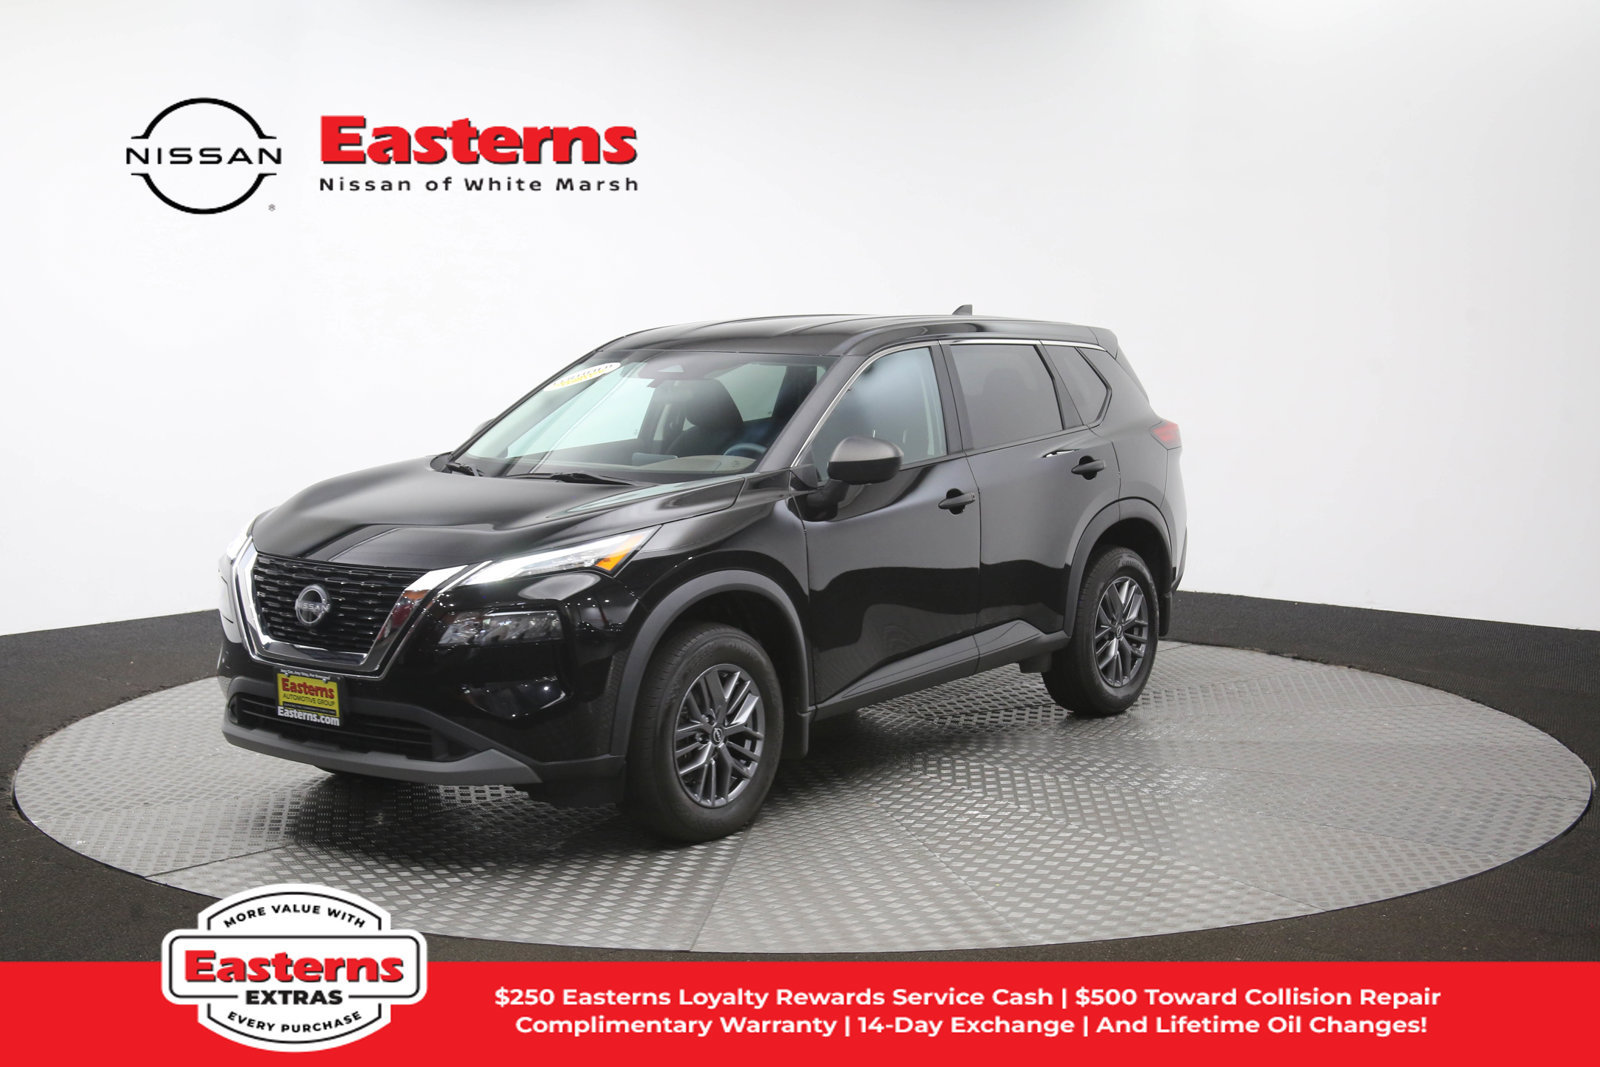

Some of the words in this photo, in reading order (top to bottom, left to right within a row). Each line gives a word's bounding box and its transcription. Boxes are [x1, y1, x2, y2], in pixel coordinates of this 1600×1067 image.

[281, 677, 335, 699] Easterns
[283, 693, 317, 704] AUTOMOTIVE
[317, 698, 336, 706] GROUP
[277, 706, 340, 726] Easterns.com
